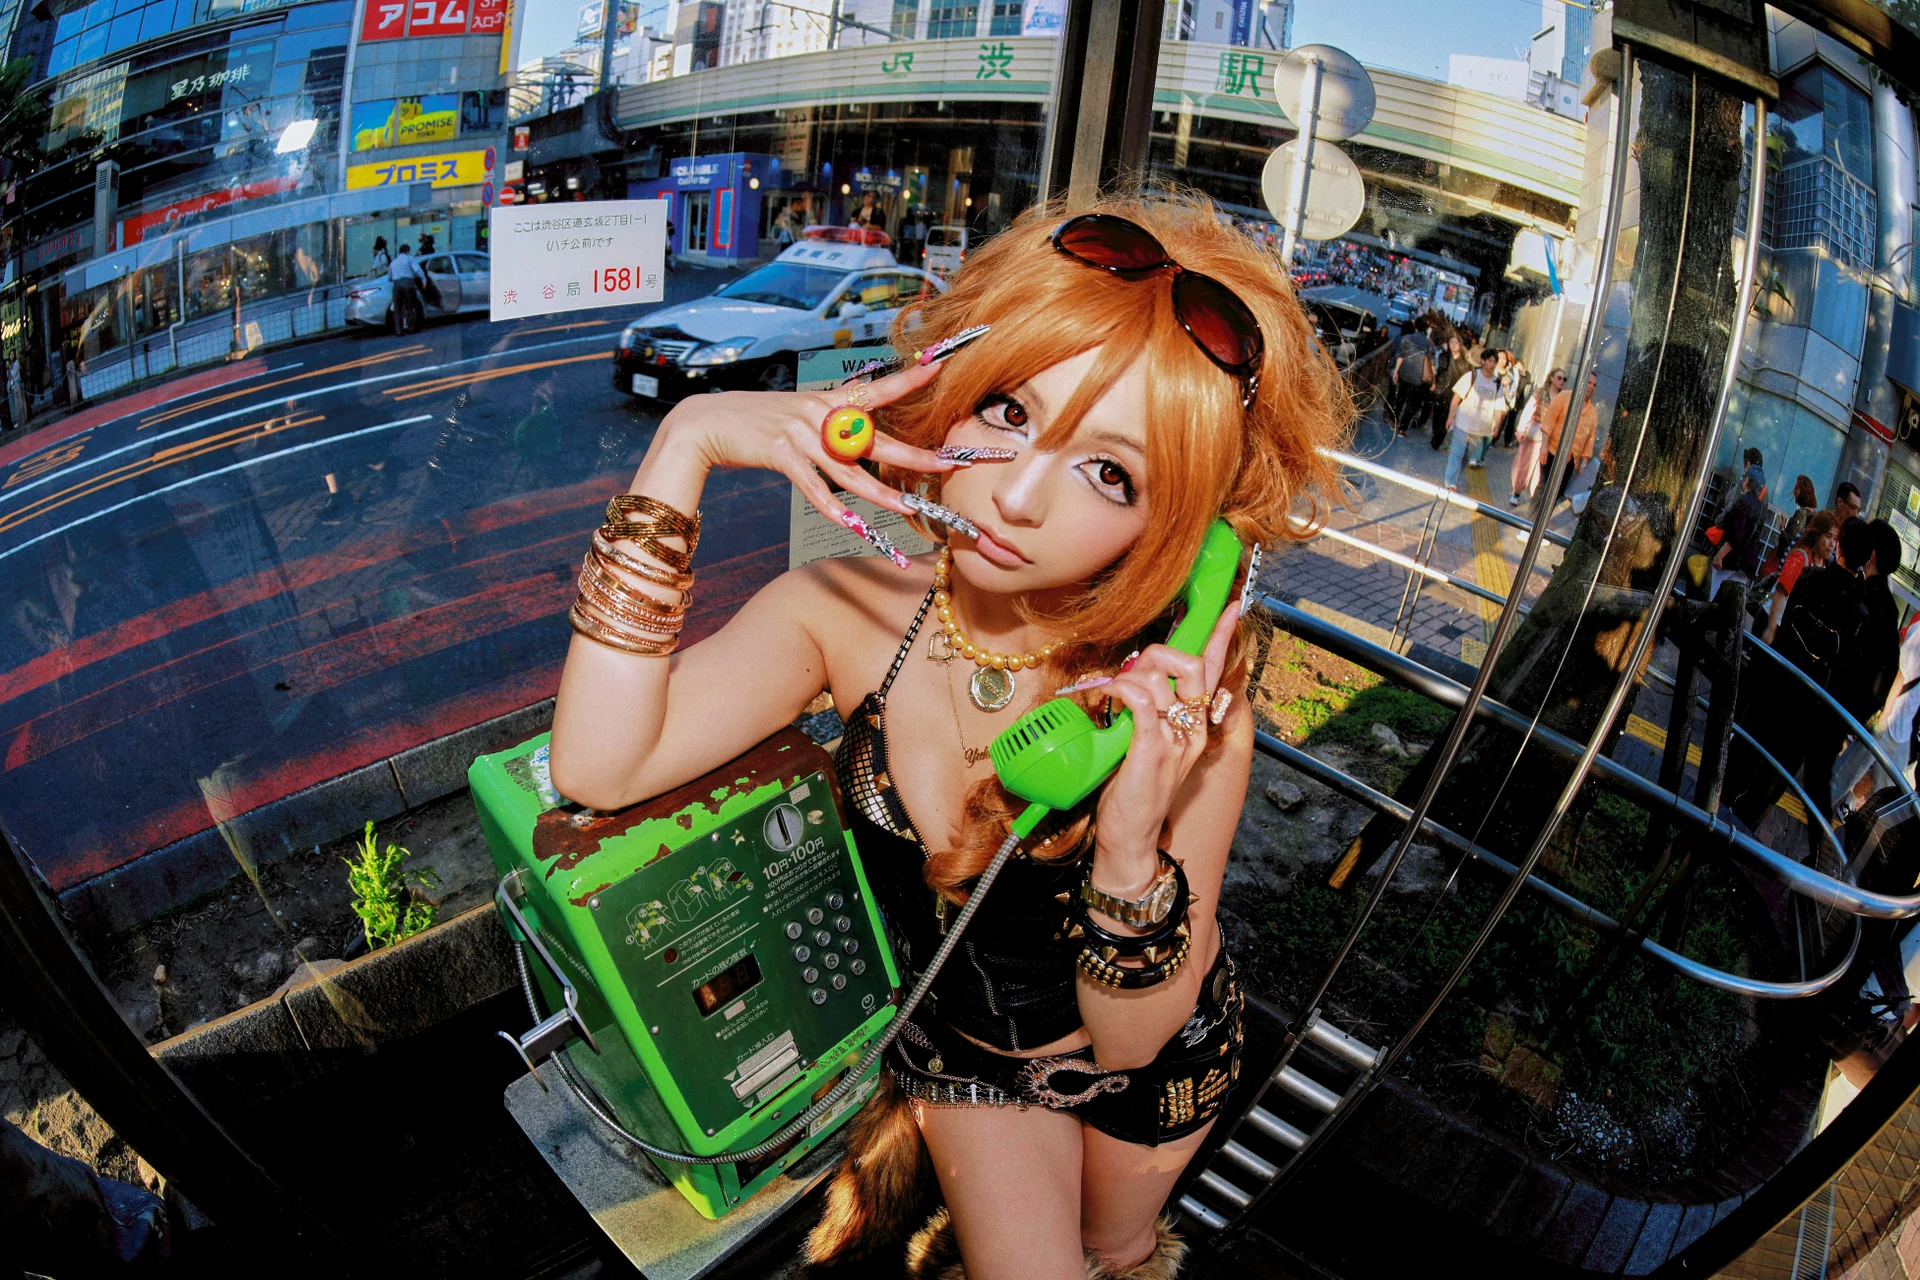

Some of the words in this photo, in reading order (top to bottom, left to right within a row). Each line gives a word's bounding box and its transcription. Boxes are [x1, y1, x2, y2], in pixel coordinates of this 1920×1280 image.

[379, 0, 465, 29] アコム
[472, 15, 494, 29] 入口
[882, 52, 914, 73] JR
[976, 42, 1014, 80] 渋
[1215, 52, 1264, 97] 駅
[401, 116, 453, 136] PROMISE
[375, 160, 459, 186] プロミス
